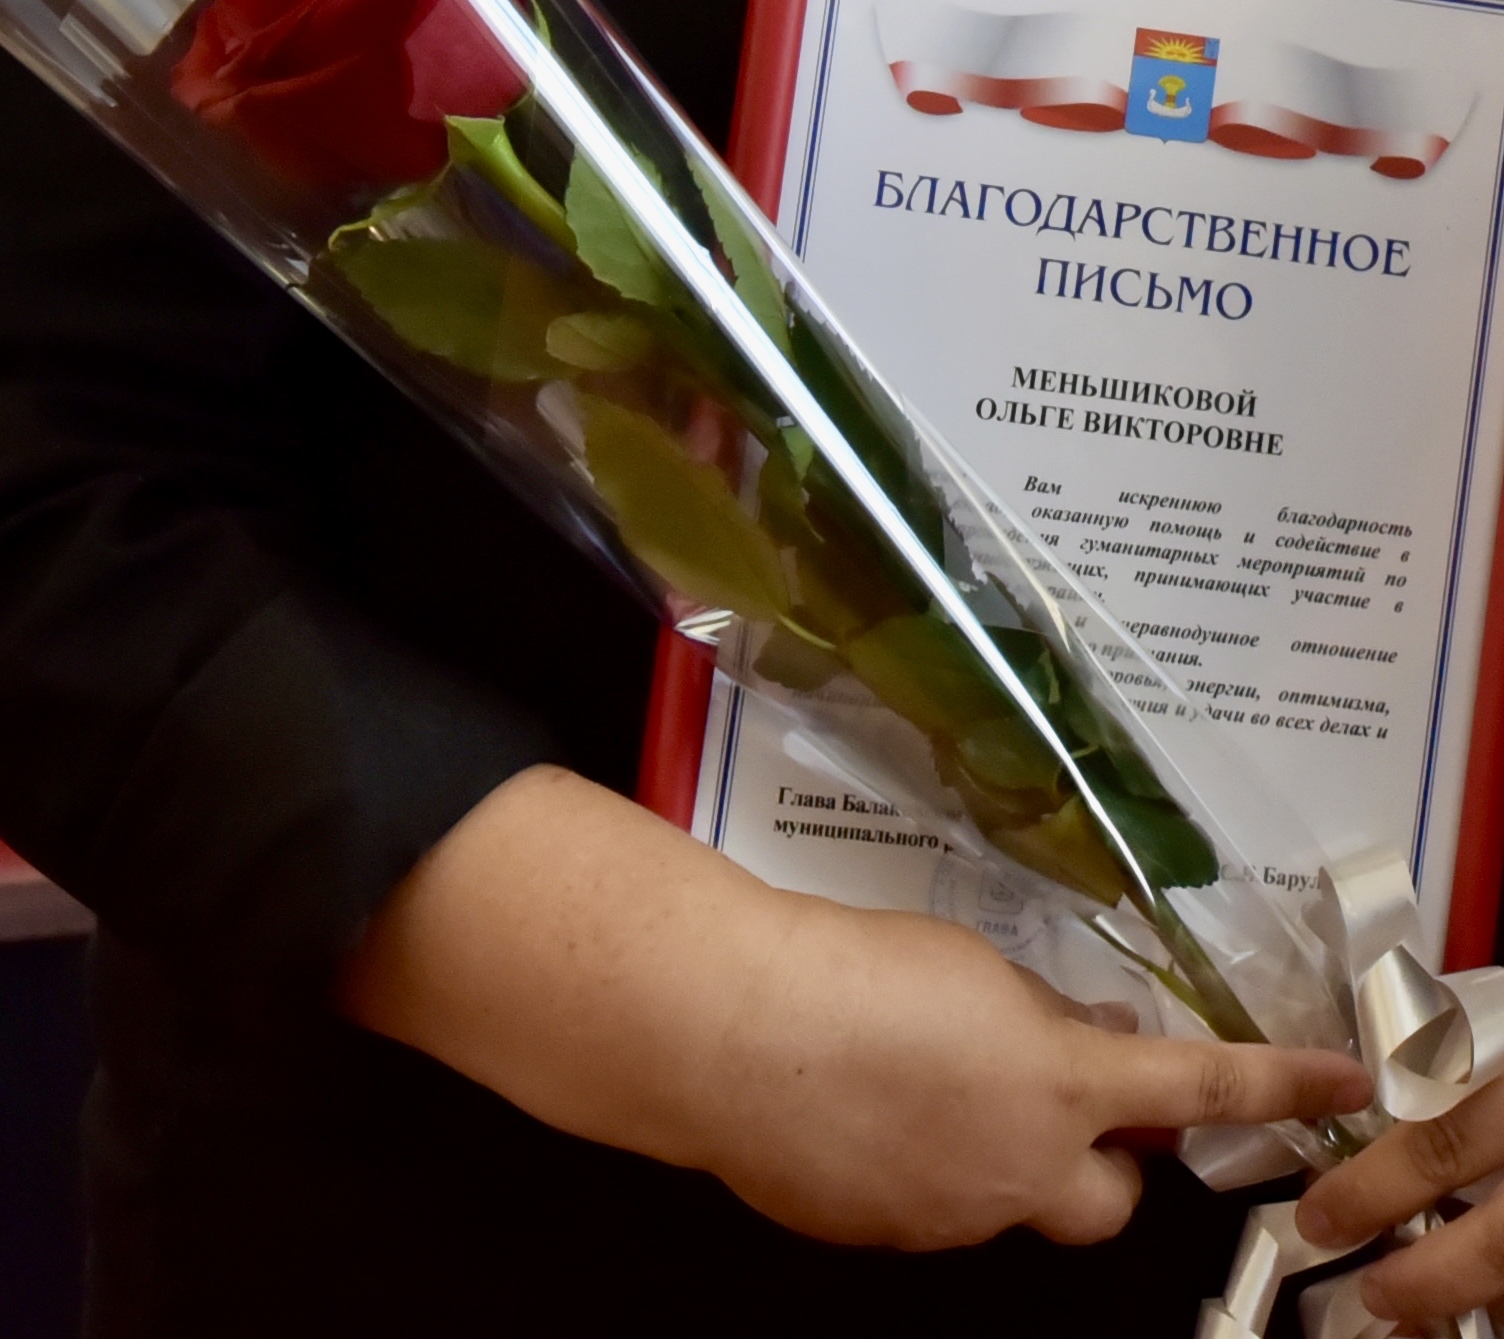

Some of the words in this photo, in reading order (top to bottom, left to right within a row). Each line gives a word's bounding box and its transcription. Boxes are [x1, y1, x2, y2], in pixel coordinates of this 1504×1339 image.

[873, 169, 1412, 278] БЛАГОДАРСТВЕННОЕ
[1034, 257, 1253, 321] ПИСЬМО
[1010, 365, 1258, 419] МЕНЬШИКОВОЙ
[975, 396, 1075, 431] ОЛЬГЕ
[1083, 416, 1285, 457] ВИКТОРОВНЕ
[1023, 475, 1062, 496] Вам
[1118, 490, 1223, 515] искреннюю
[1276, 506, 1414, 539] благодарность
[1031, 506, 1130, 531] оказанную
[1148, 519, 1223, 542] помощь
[1243, 531, 1256, 544] и
[1275, 535, 1382, 560] содействие
[1400, 550, 1411, 563] в
[1080, 537, 1220, 566] гуманитарных
[1236, 555, 1366, 584] мероприятий
[1384, 573, 1408, 588] по
[1133, 569, 1271, 599] принимающих
[1290, 586, 1372, 610] участие
[1393, 599, 1405, 614] в
[1290, 639, 1399, 664] отношение
[1185, 678, 1262, 702] энергии,
[1277, 688, 1392, 716] оптимизма,
[1249, 712, 1271, 727] во
[1275, 715, 1316, 731] всех
[1318, 717, 1373, 739] делах
[1376, 726, 1389, 740] и
[777, 786, 837, 811] Глава
[773, 817, 939, 850] муниципального
